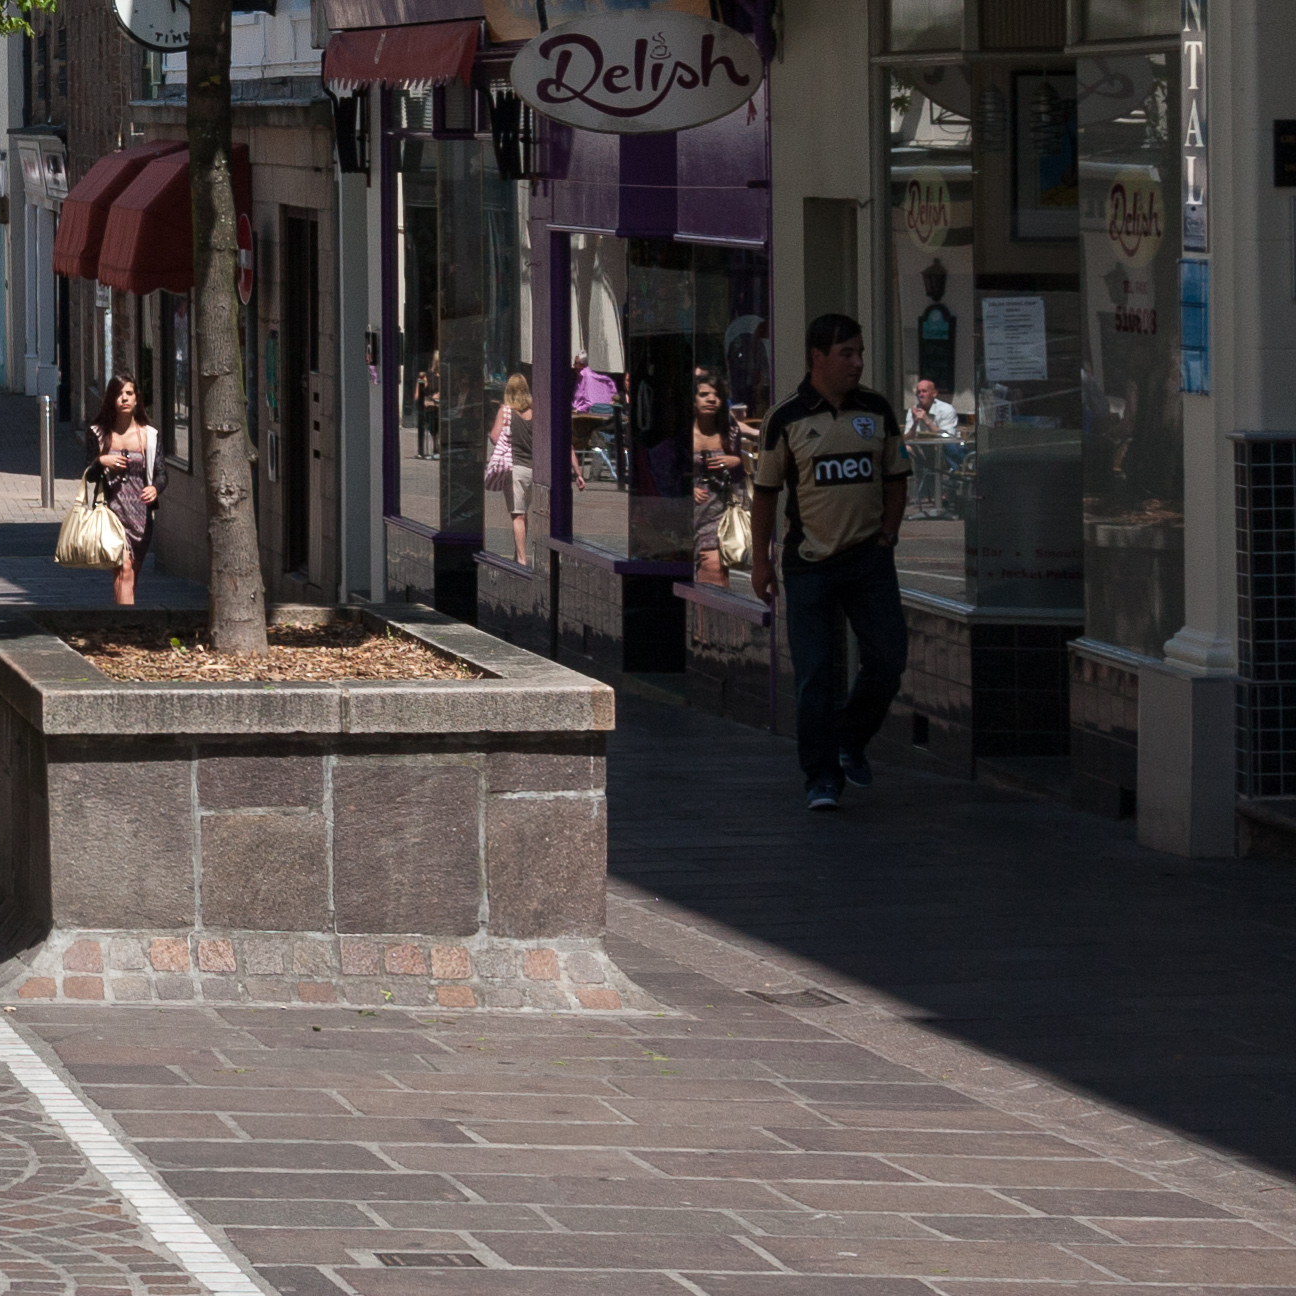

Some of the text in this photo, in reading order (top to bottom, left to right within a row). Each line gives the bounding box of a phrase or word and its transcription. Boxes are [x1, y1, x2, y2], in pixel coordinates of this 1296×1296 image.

[536, 32, 750, 118] Delish
[906, 178, 949, 245] Delish
[1108, 182, 1163, 257] Delish
[814, 456, 873, 481] meo
